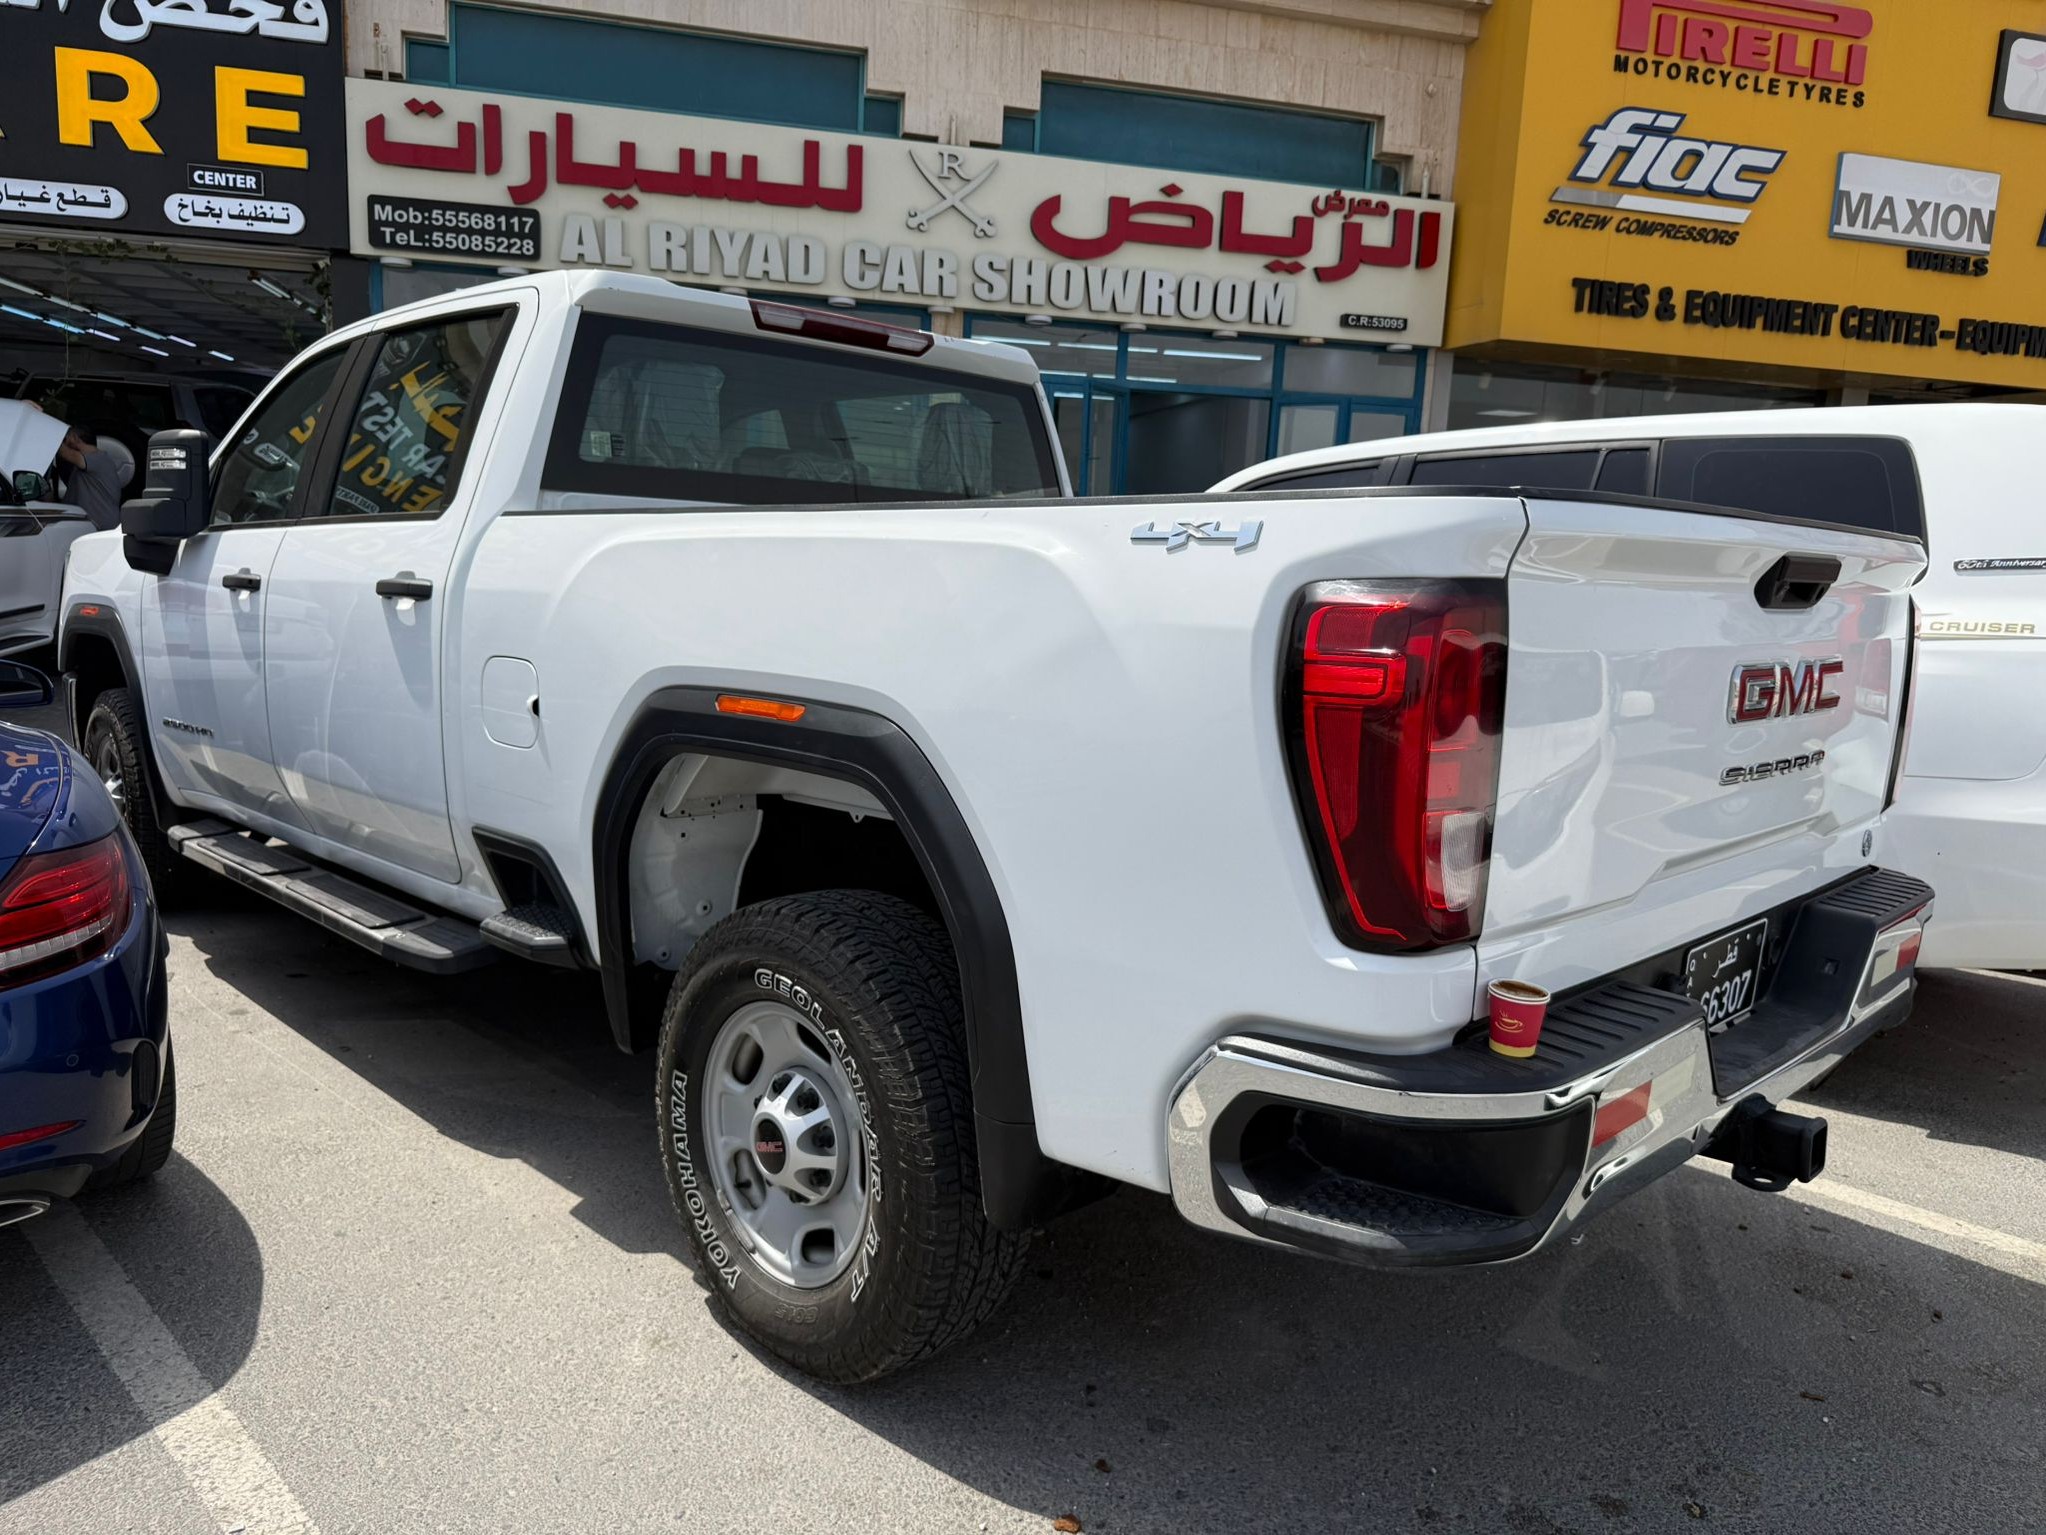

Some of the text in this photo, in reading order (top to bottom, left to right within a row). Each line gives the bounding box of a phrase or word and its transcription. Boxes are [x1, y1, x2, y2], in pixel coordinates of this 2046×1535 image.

[1616, 0, 1873, 86] PIRELLI
[938, 151, 971, 181] R
[1567, 106, 1788, 204] fiac
[193, 170, 257, 189] CENTER
[365, 98, 1441, 283] الرياض للسيارات
[56, 186, 111, 212] قطع
[177, 198, 291, 227] تنظيف بخاخ
[1311, 189, 1390, 221] معرض
[1835, 190, 1996, 244] MAXION
[374, 204, 534, 234] Mob:55568117
[1543, 208, 1741, 246] SCREW COMPRESSORS
[559, 214, 1297, 327] AL RIYAD CAR SHOWROOM
[1906, 249, 1989, 277] WHEELS
[1348, 315, 1404, 330] C.R:53095
[1572, 277, 1650, 319] TIRES
[1655, 286, 1676, 321] &
[1683, 289, 1839, 336] EQUIPMENT
[1929, 621, 2036, 634] CRUISER
[1727, 654, 1844, 724] GMC
[1719, 749, 1825, 786] SIERRA
[1711, 937, 1740, 979] قطر
[756, 1141, 783, 1153] GMC
[671, 1068, 742, 1293] YOKOHAMA
